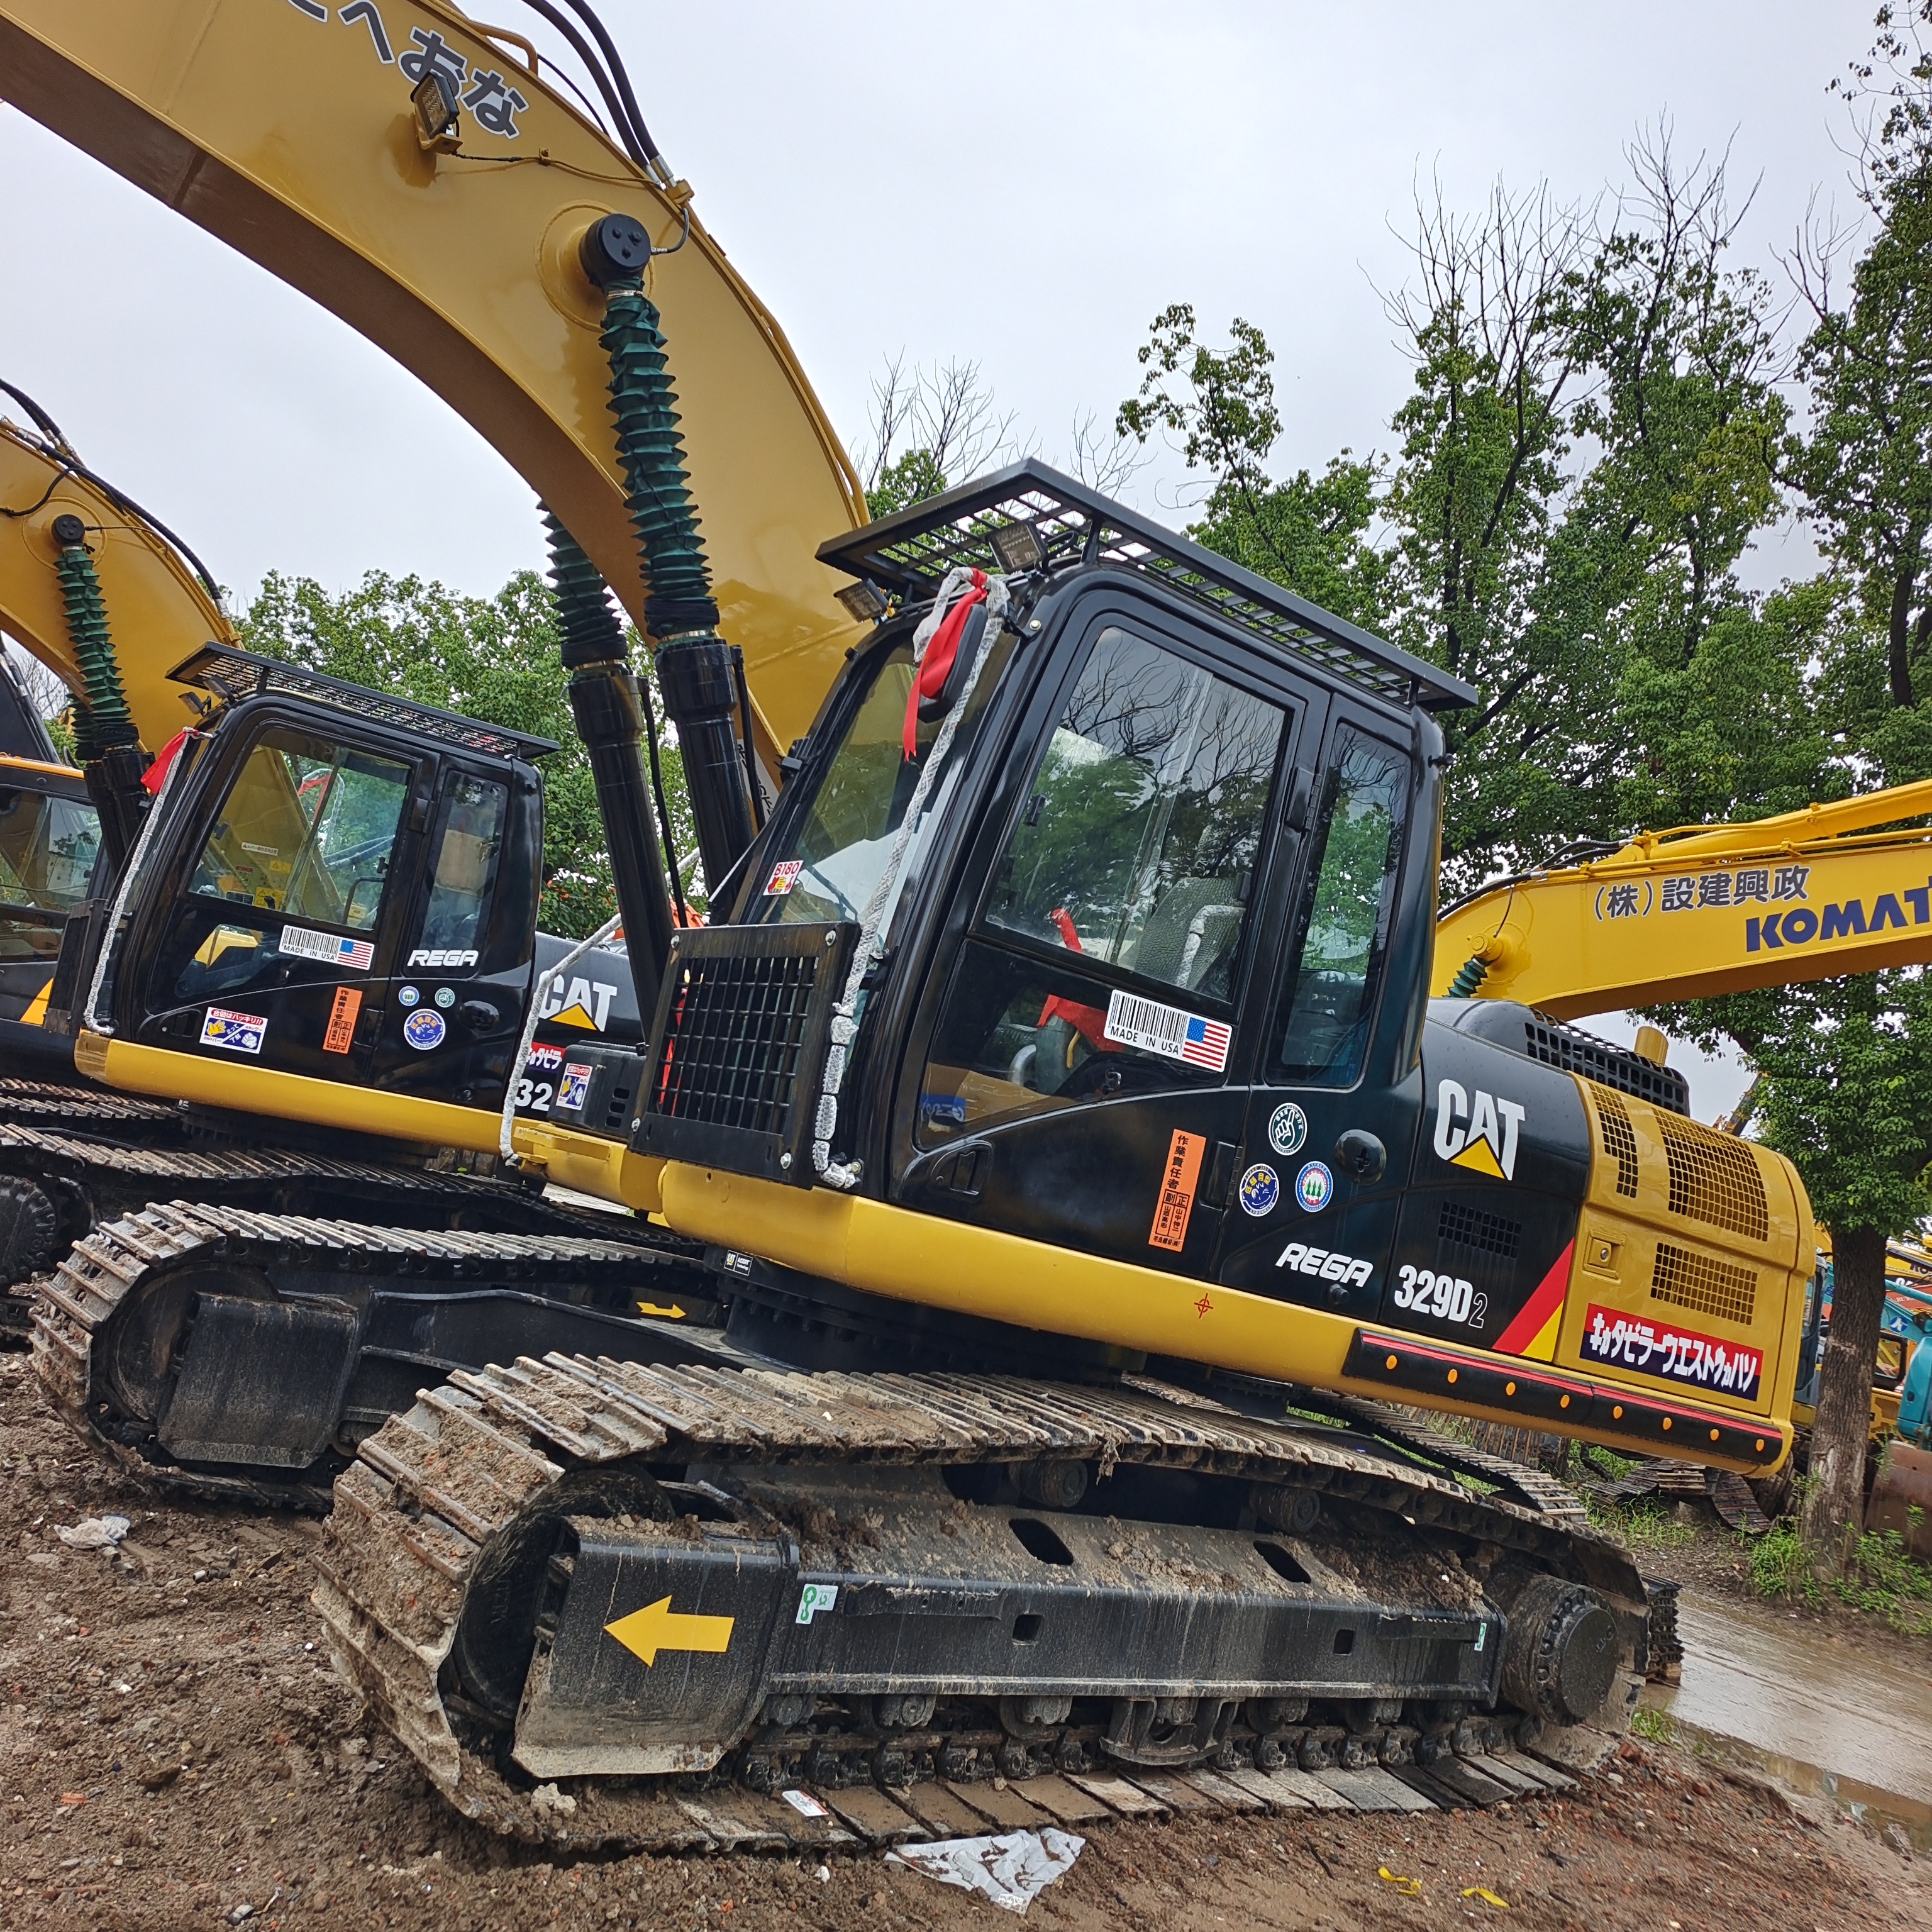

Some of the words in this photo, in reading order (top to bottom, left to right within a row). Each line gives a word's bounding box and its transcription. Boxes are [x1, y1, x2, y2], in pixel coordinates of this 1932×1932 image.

[774, 862, 799, 876] B180
[283, 945, 304, 955] MADE
[321, 952, 335, 961] USA
[406, 950, 479, 967] REGA
[538, 970, 618, 1032] CAT
[1110, 1025, 1138, 1043] MADE
[1145, 1036, 1157, 1048] IN
[1161, 1041, 1179, 1055] USA
[1433, 1079, 1525, 1181] CAT
[1167, 1135, 1189, 1190] 作業責任者
[1165, 1192, 1176, 1204] 副
[1177, 1195, 1187, 1207] 正
[1275, 1242, 1374, 1287] REGA
[1394, 1265, 1488, 1329] 329D2
